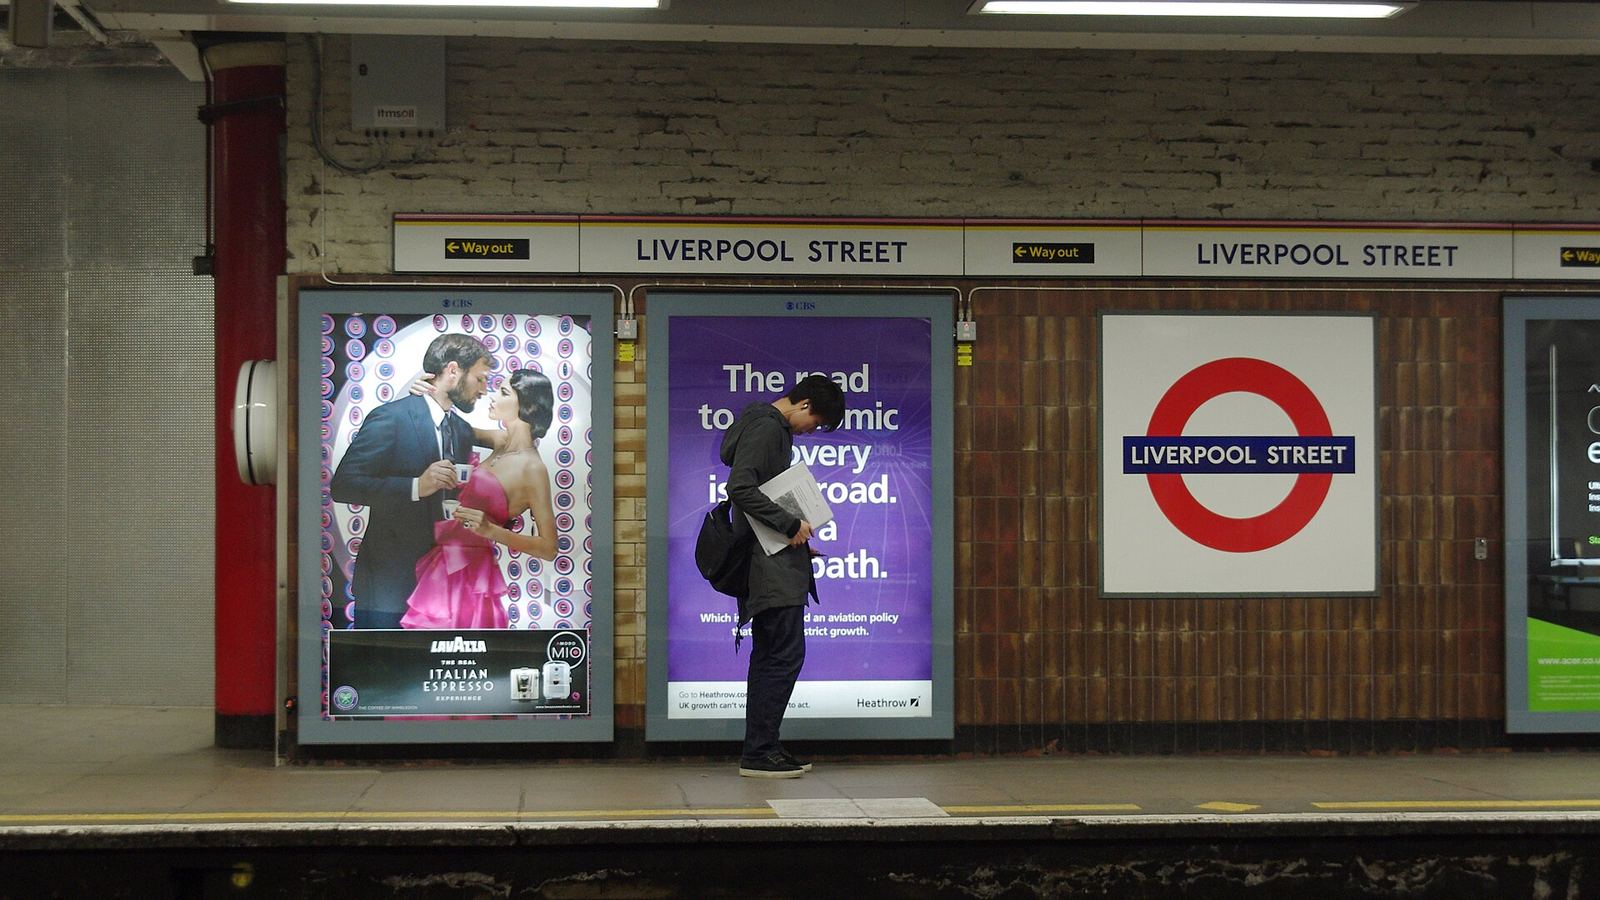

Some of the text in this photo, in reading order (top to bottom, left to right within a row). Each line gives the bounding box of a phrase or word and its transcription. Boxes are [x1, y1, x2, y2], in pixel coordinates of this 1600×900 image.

[462, 242, 513, 255] Way out
[637, 239, 907, 263] LIVERPOOL STREET
[1029, 246, 1079, 259] Way out
[1198, 243, 1458, 267] LIVERPOOL STREET
[1576, 251, 1600, 264] Way
[723, 363, 869, 392] The rad
[698, 403, 735, 430] to
[790, 445, 872, 474] very
[1131, 446, 1347, 464] LIVERPOOL STREET
[709, 474, 729, 504] is
[816, 474, 897, 504] road.
[818, 520, 837, 541] a
[700, 613, 731, 623] Which
[828, 612, 867, 623] aviation
[869, 612, 899, 624] policy
[804, 626, 869, 638] strict growth.
[430, 636, 487, 653] LAVAZZA
[552, 646, 581, 658] MIO
[430, 669, 488, 679] ITALIAN
[423, 681, 494, 692] ESPRESSO
[679, 691, 689, 699] Go
[699, 690, 748, 698] Heathrow.co
[691, 702, 718, 711] growth
[857, 698, 907, 708] Heathrow
